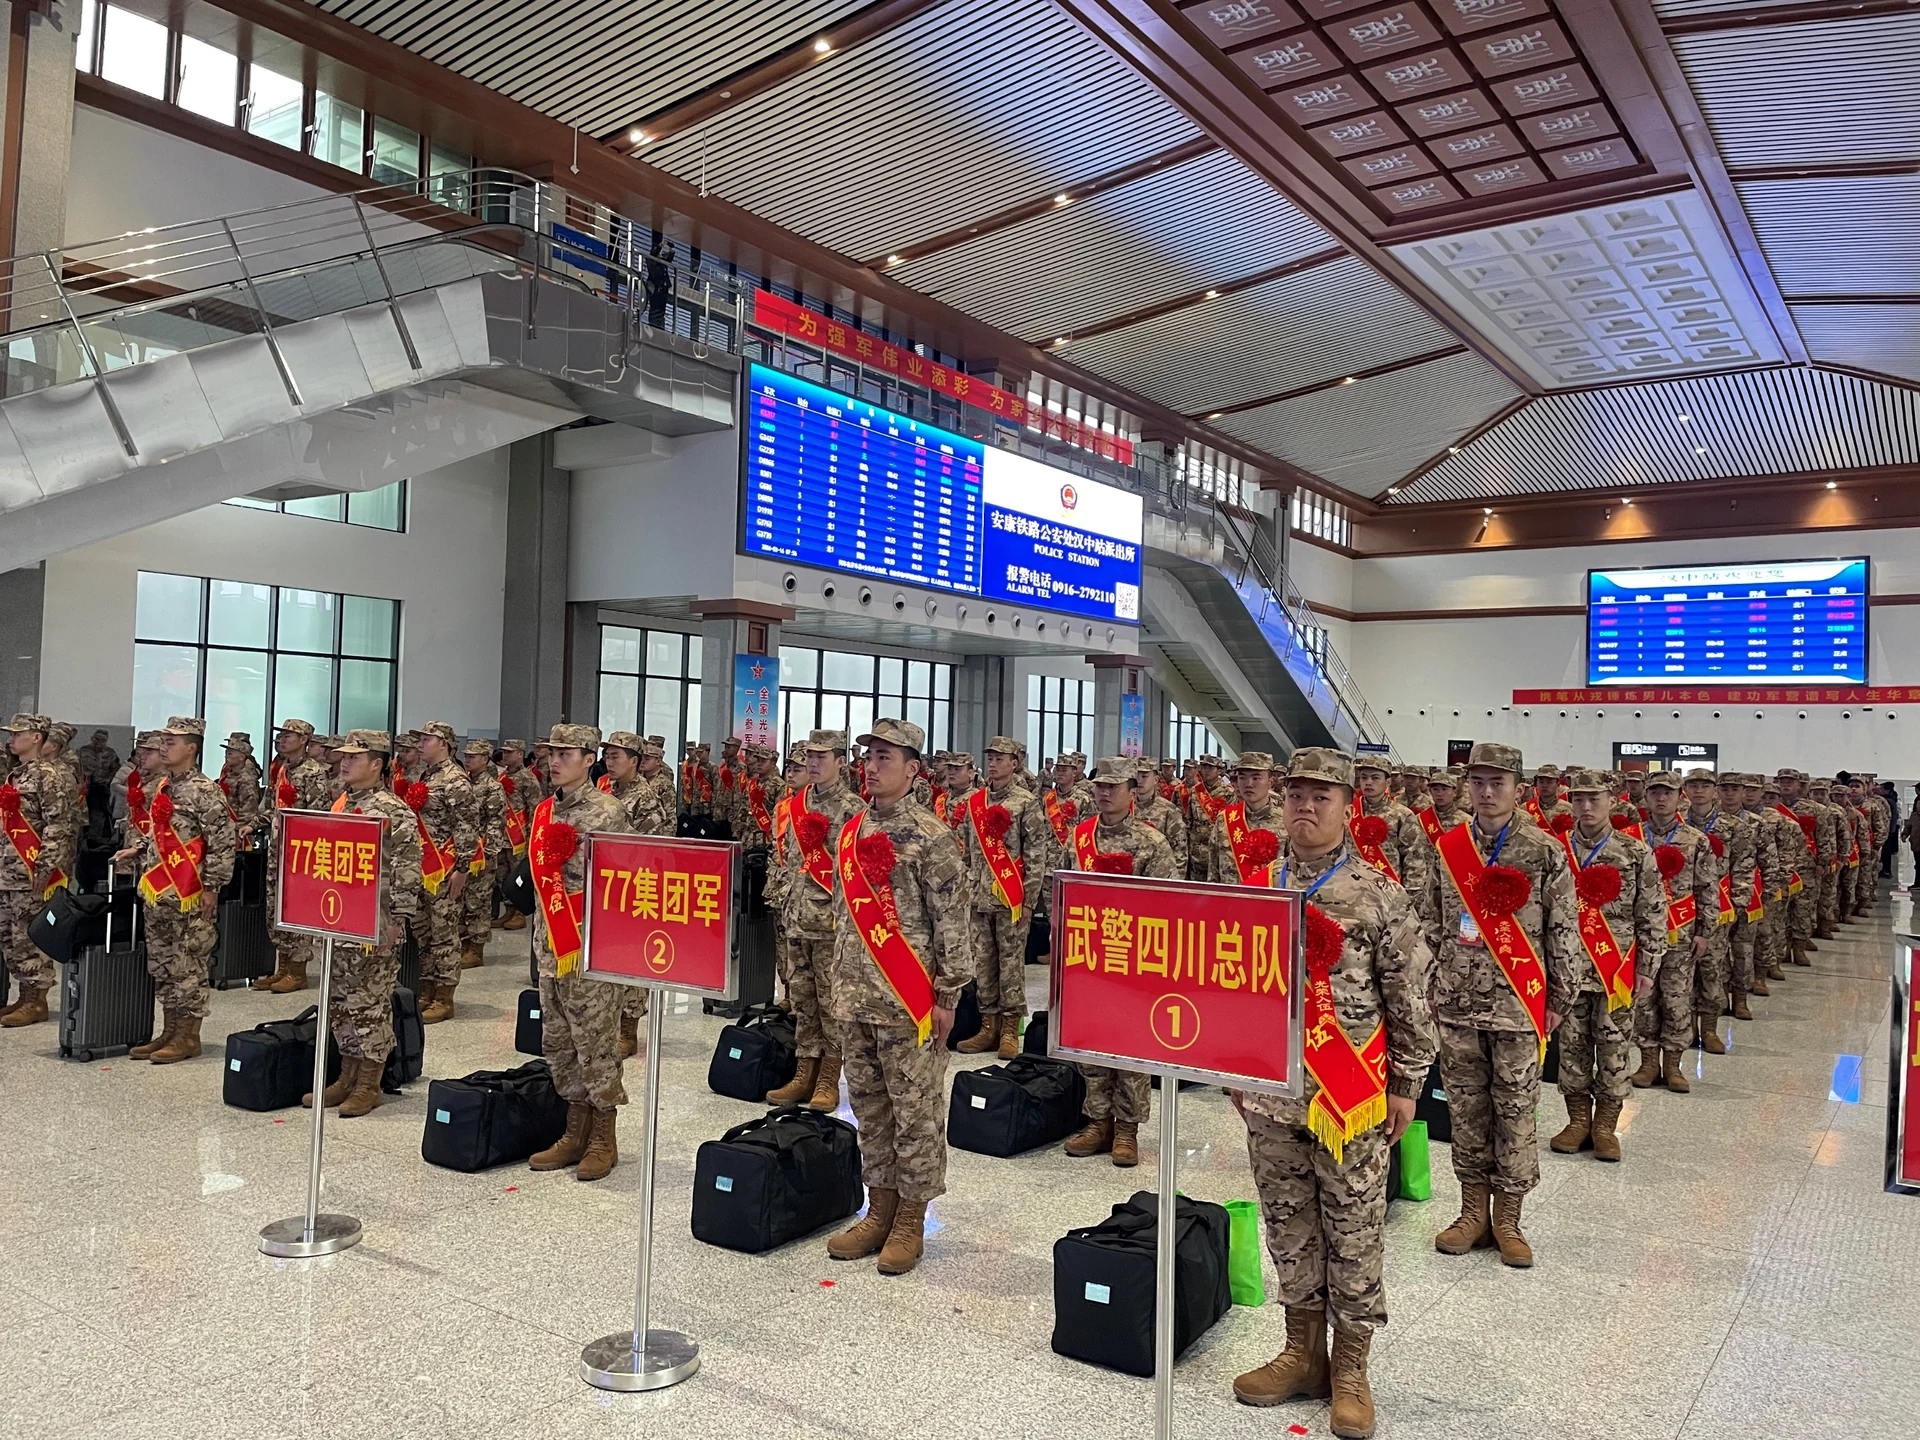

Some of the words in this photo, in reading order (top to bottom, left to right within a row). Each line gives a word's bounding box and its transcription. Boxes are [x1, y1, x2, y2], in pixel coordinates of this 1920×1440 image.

[799, 312, 969, 396] 为强军伟业添彩
[991, 510, 1136, 563] 安康铁路公安处汉中站派出所
[1034, 543, 1064, 560] POLICE
[1068, 552, 1100, 567] STATION
[1006, 564, 1052, 589] 报警电话
[1052, 581, 1115, 604] 0916-2792110
[1006, 583, 1034, 596] ALARM
[1036, 587, 1051, 599] TEL
[744, 689, 756, 745] 一人参军
[758, 686, 769, 746] 全家光荣
[290, 837, 376, 886] 77集团军
[600, 866, 722, 928] 77集团军
[1065, 904, 1288, 997] 武警四川总队
